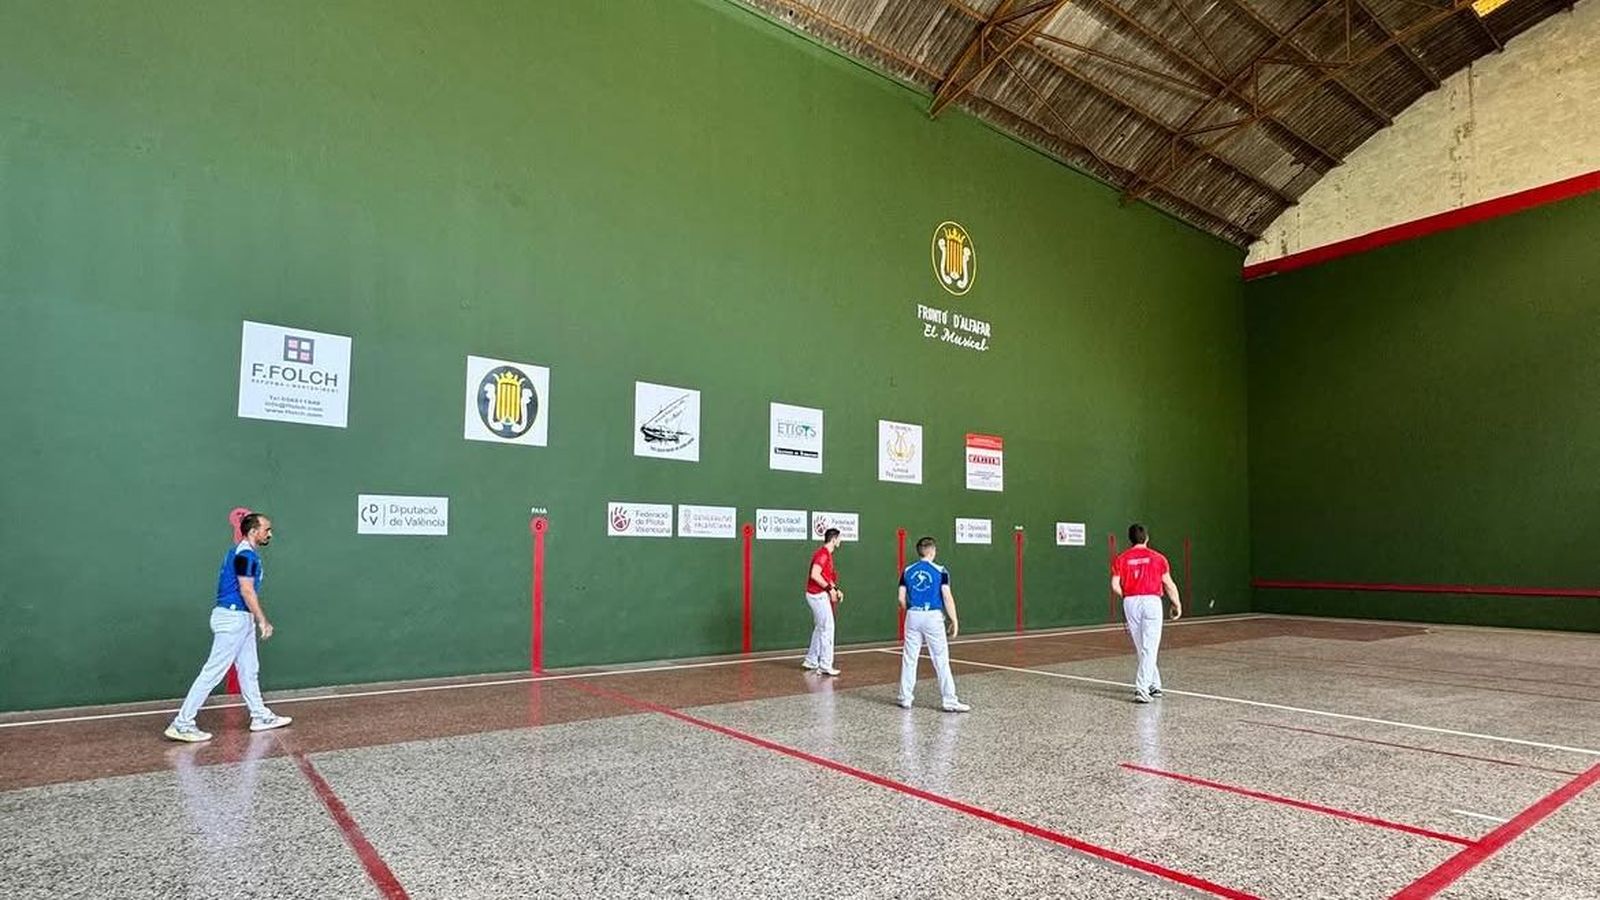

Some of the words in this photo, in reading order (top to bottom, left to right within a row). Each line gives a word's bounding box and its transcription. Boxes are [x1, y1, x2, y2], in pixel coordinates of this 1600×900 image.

[917, 304, 948, 325] FRONTÓ
[924, 322, 938, 338] El
[941, 328, 989, 351] Musical
[252, 363, 338, 387] F.FOLCH
[390, 504, 438, 516] Diputació
[635, 510, 668, 519] Federació
[389, 517, 403, 527] de
[405, 516, 445, 527] València
